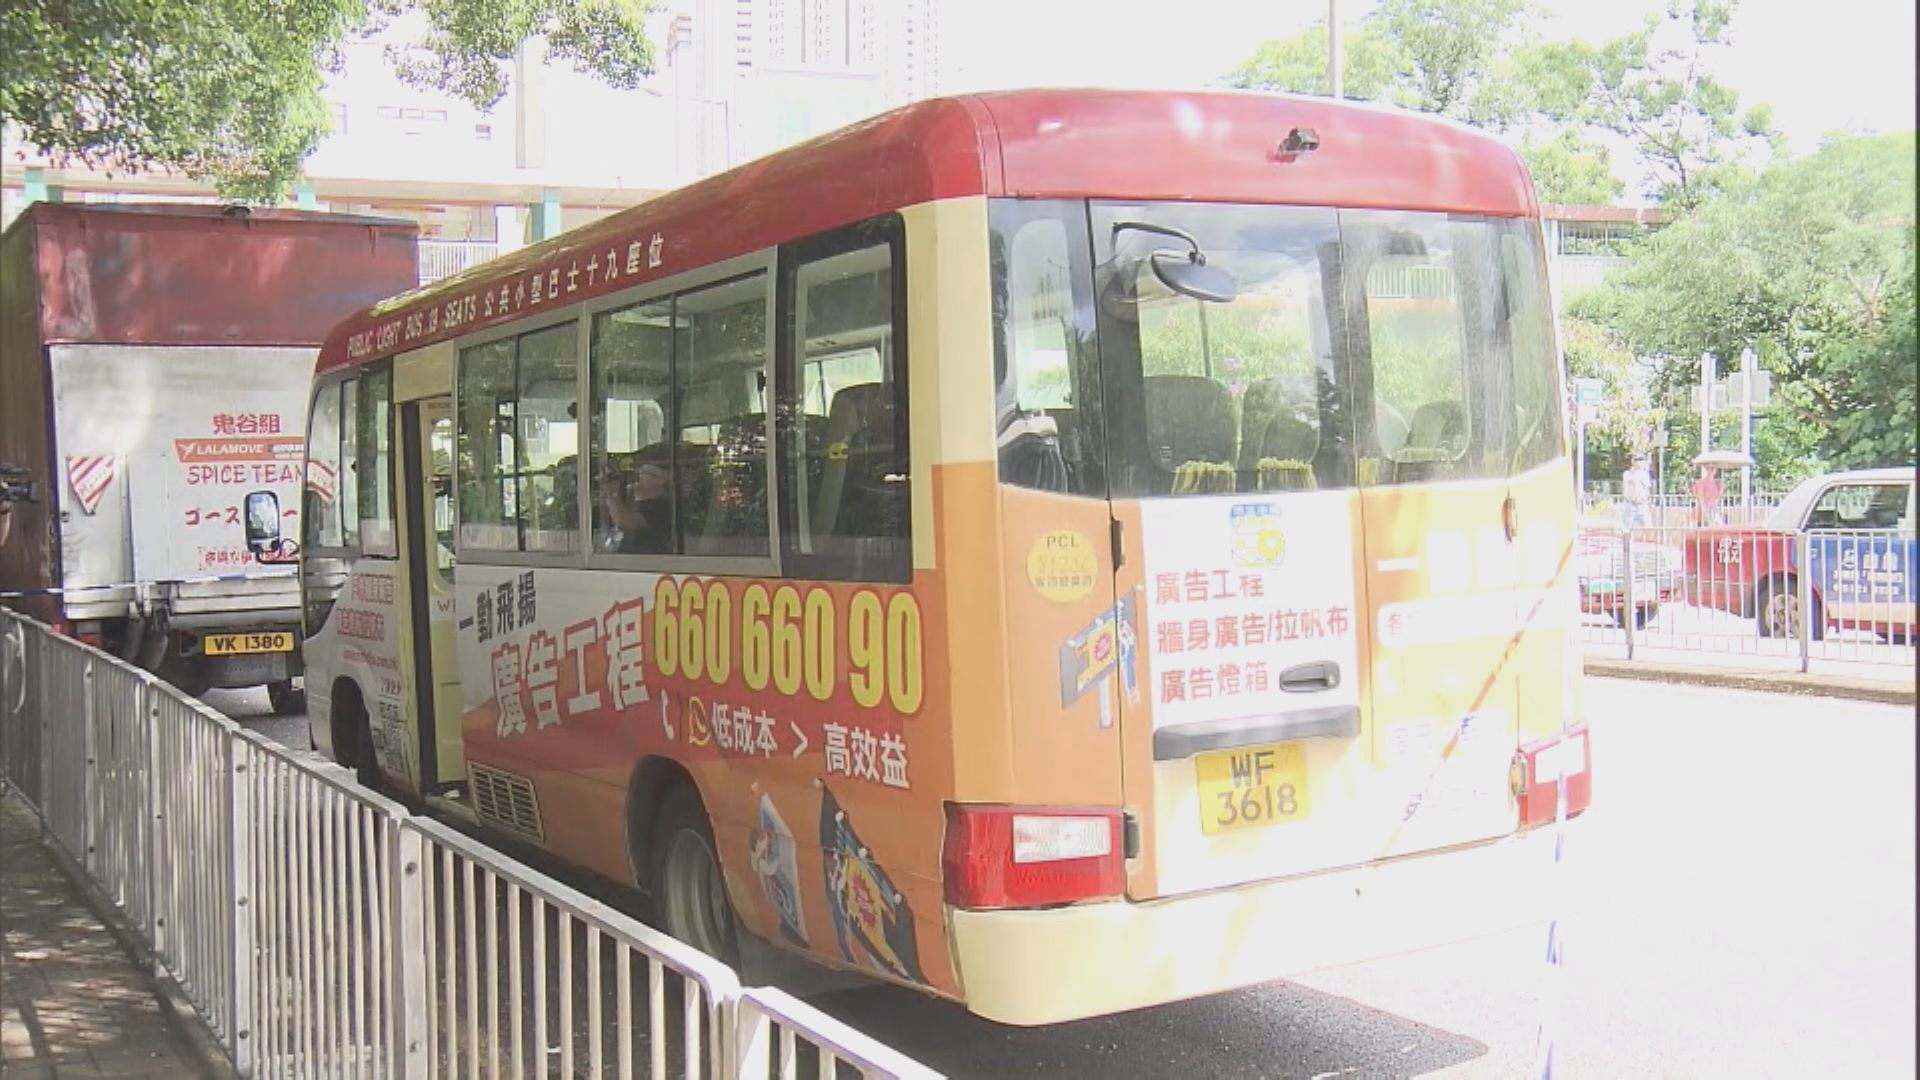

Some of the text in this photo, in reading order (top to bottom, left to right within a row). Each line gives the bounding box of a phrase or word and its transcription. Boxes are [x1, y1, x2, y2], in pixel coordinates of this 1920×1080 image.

[346, 330, 374, 359] PUBLIC
[376, 319, 402, 350] LIGHT
[405, 311, 424, 340] BUS
[444, 293, 477, 329] SEATS
[484, 232, 665, 317] 公共小型巴士十九座位
[196, 443, 264, 455] LALAMOVE
[187, 464, 246, 485] SPICE
[1155, 569, 1265, 605] 廣告工程
[212, 633, 285, 652] VK 1380
[654, 576, 923, 715] 660 660 90
[491, 597, 650, 737] 廣告工程
[1160, 660, 1269, 704] 廣告燈箱
[711, 701, 778, 758] 低成本
[822, 721, 910, 790] 高效益
[1231, 750, 1275, 788] WF
[1216, 782, 1299, 827] 3618
